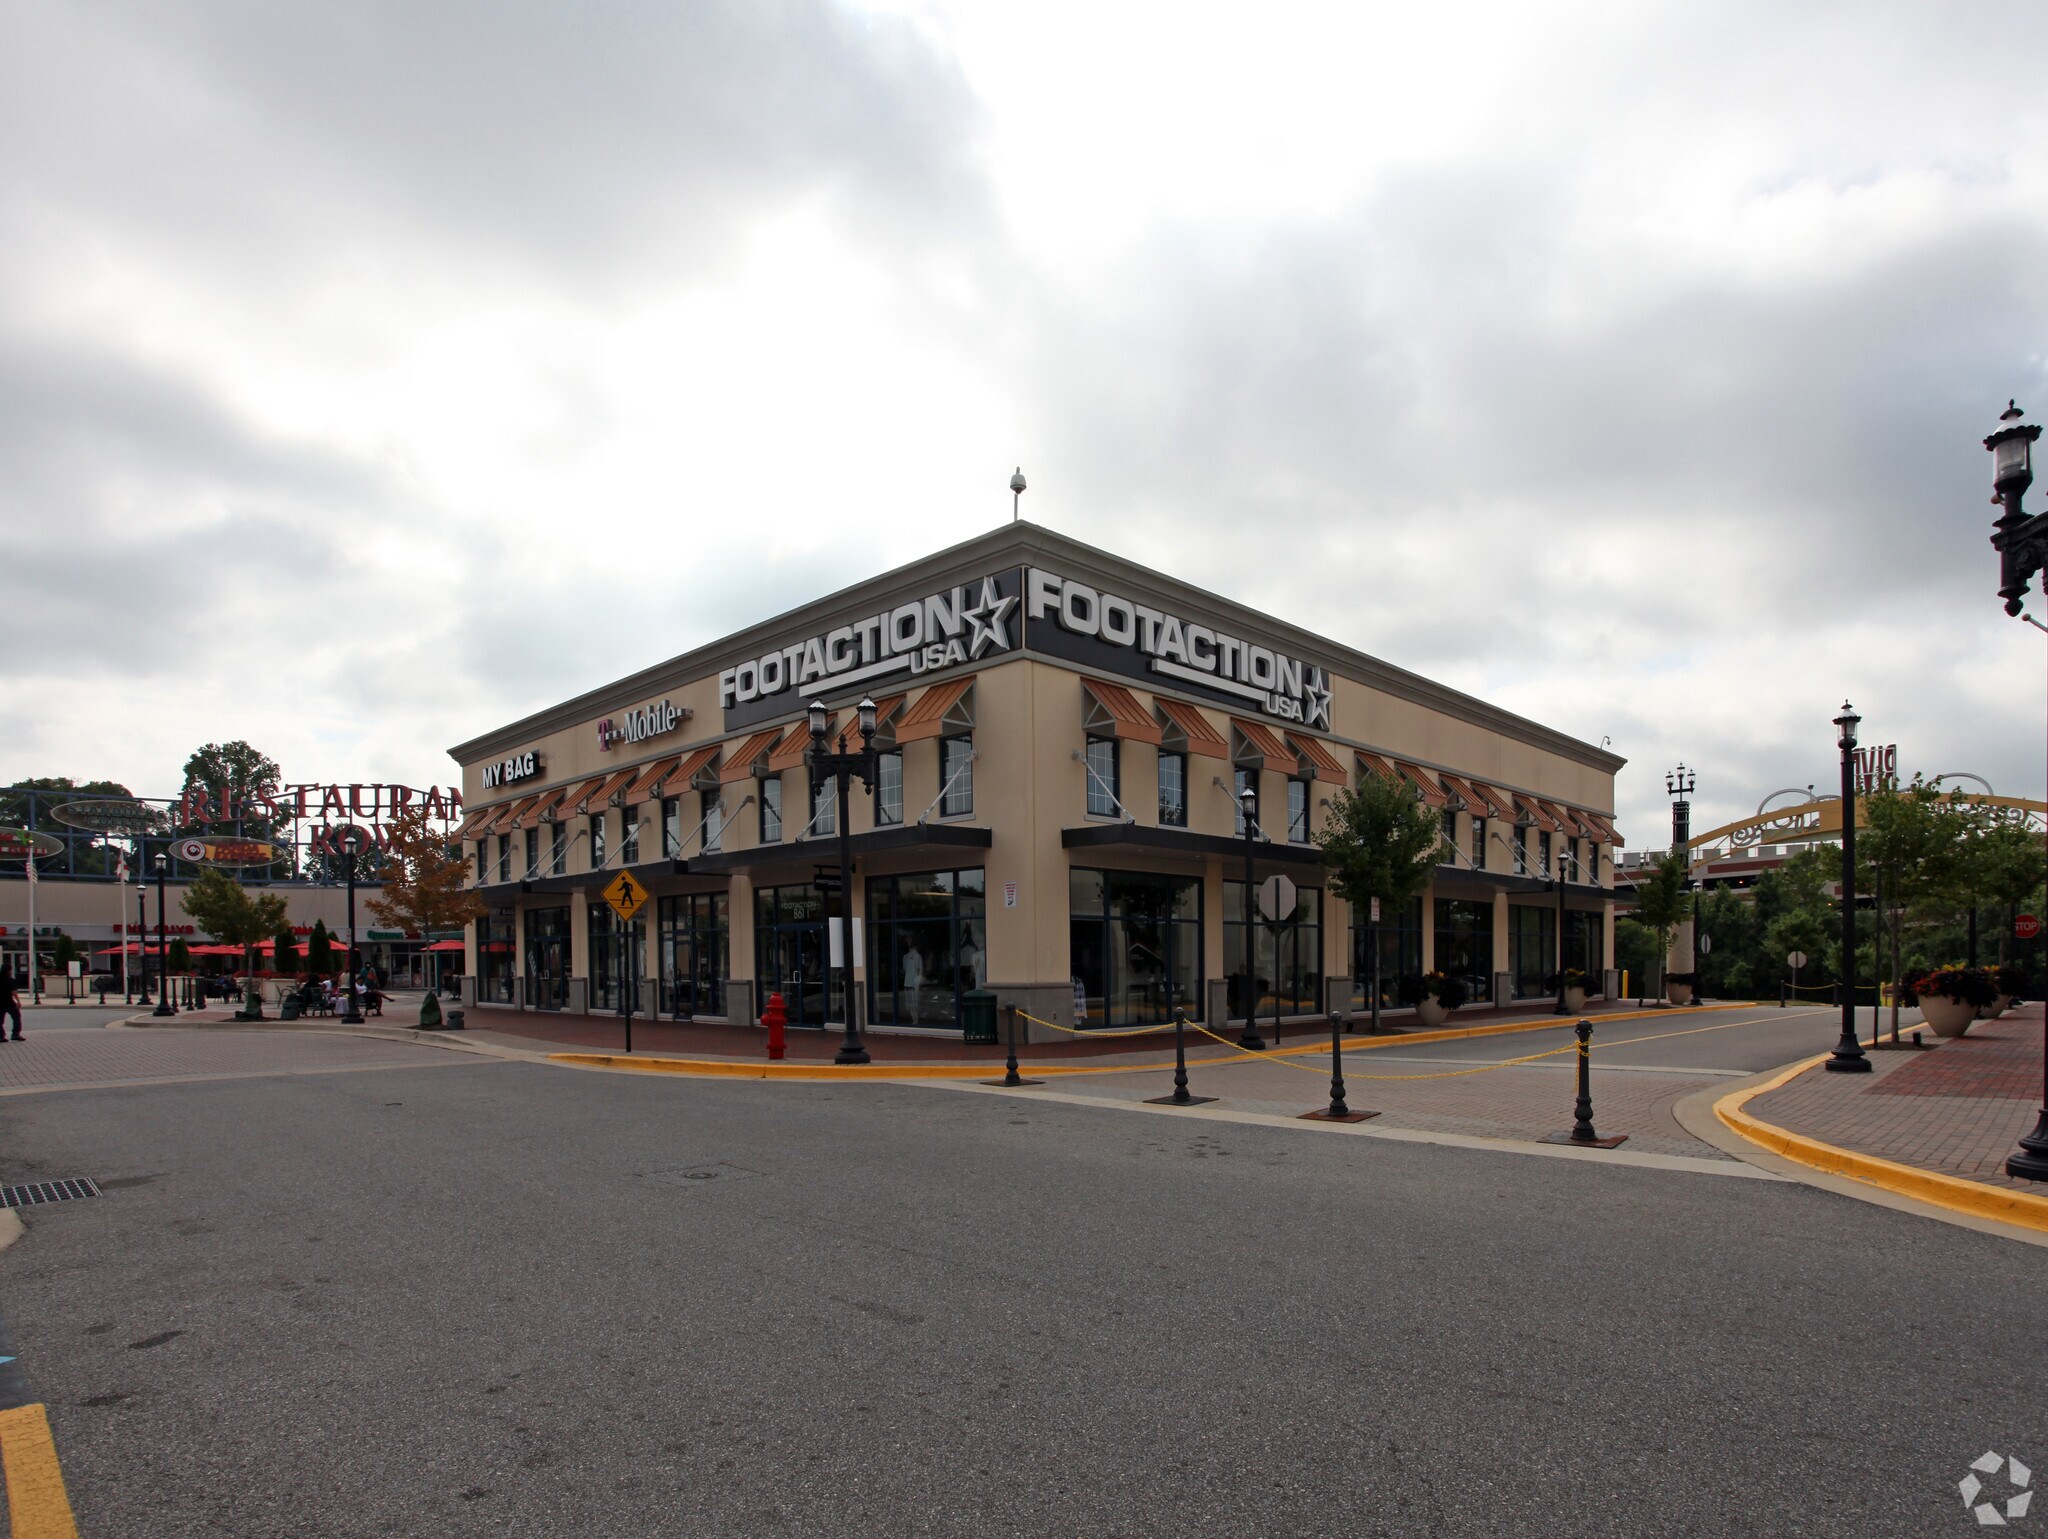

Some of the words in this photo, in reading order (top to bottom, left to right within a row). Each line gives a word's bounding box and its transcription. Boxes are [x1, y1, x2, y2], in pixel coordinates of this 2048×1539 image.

[719, 586, 966, 709] FOOTACTION
[1028, 567, 1302, 699] FOOTACTION
[910, 638, 967, 674] USA
[1262, 692, 1304, 723] USA
[482, 762, 502, 789] MY
[505, 752, 535, 782] BAG
[67, 805, 165, 818] STARBUCKS
[179, 783, 463, 827] RESTAURAN
[87, 816, 148, 828] COFFEE
[793, 908, 810, 920] 8611
[2015, 921, 2038, 931] STOP
